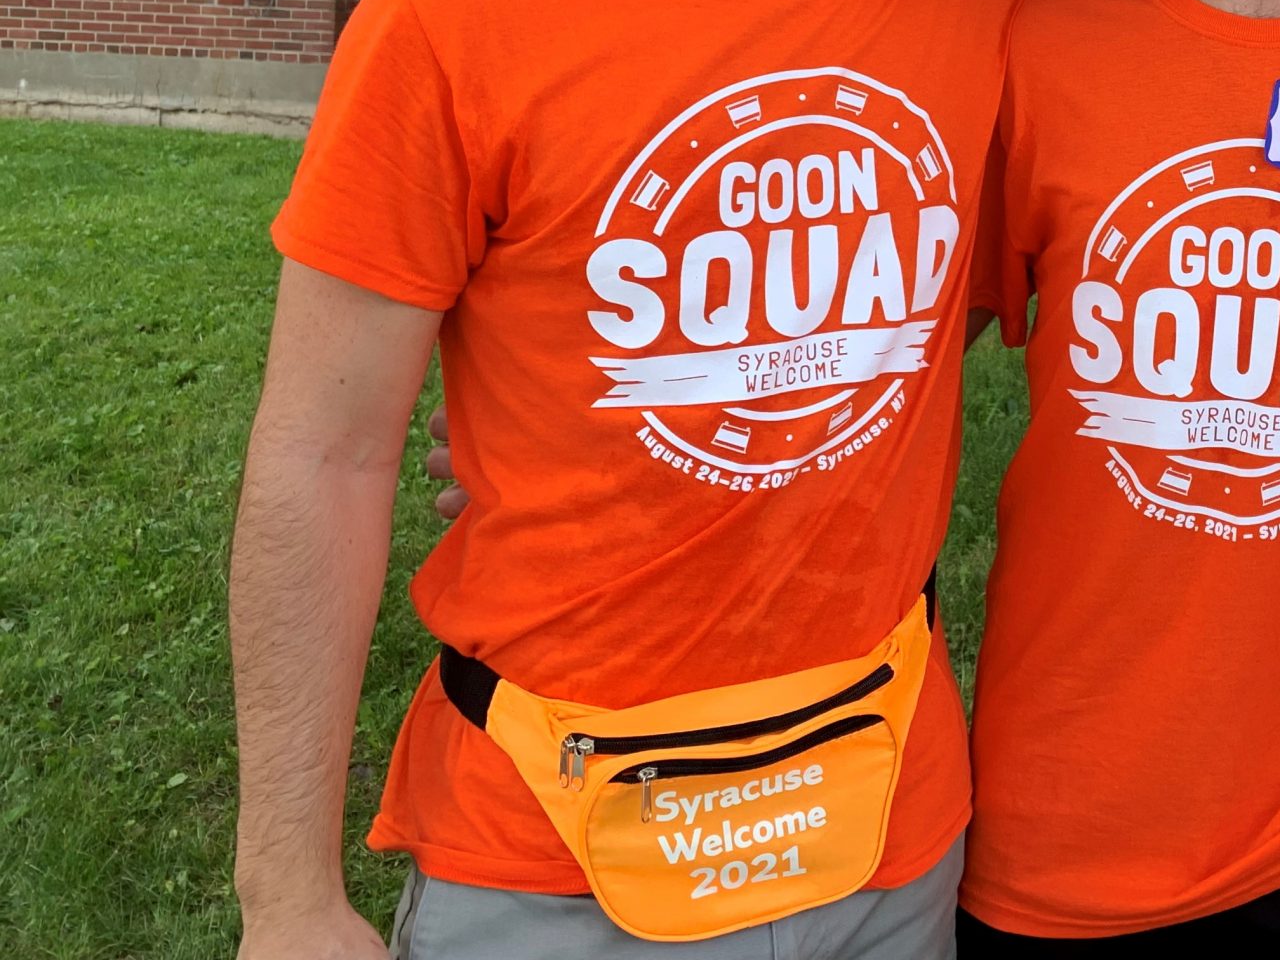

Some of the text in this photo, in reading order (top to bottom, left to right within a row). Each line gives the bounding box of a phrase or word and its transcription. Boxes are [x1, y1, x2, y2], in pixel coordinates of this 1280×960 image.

[719, 147, 879, 228] GOON
[586, 204, 960, 349] SQUAD
[737, 338, 849, 372] SYRACUSE
[745, 359, 843, 393] WELCOME
[635, 425, 694, 474] August
[695, 465, 756, 493] 24-26,
[816, 417, 893, 471] Syracuse,
[890, 389, 906, 414] NY
[1187, 429, 1275, 451] WELCOME
[1105, 459, 1142, 510] August
[1143, 503, 1199, 532] 24-26,
[1204, 518, 1237, 542] 2021
[654, 764, 824, 825] Syracuse
[657, 805, 827, 865] Welcome
[690, 845, 807, 900] 2021
